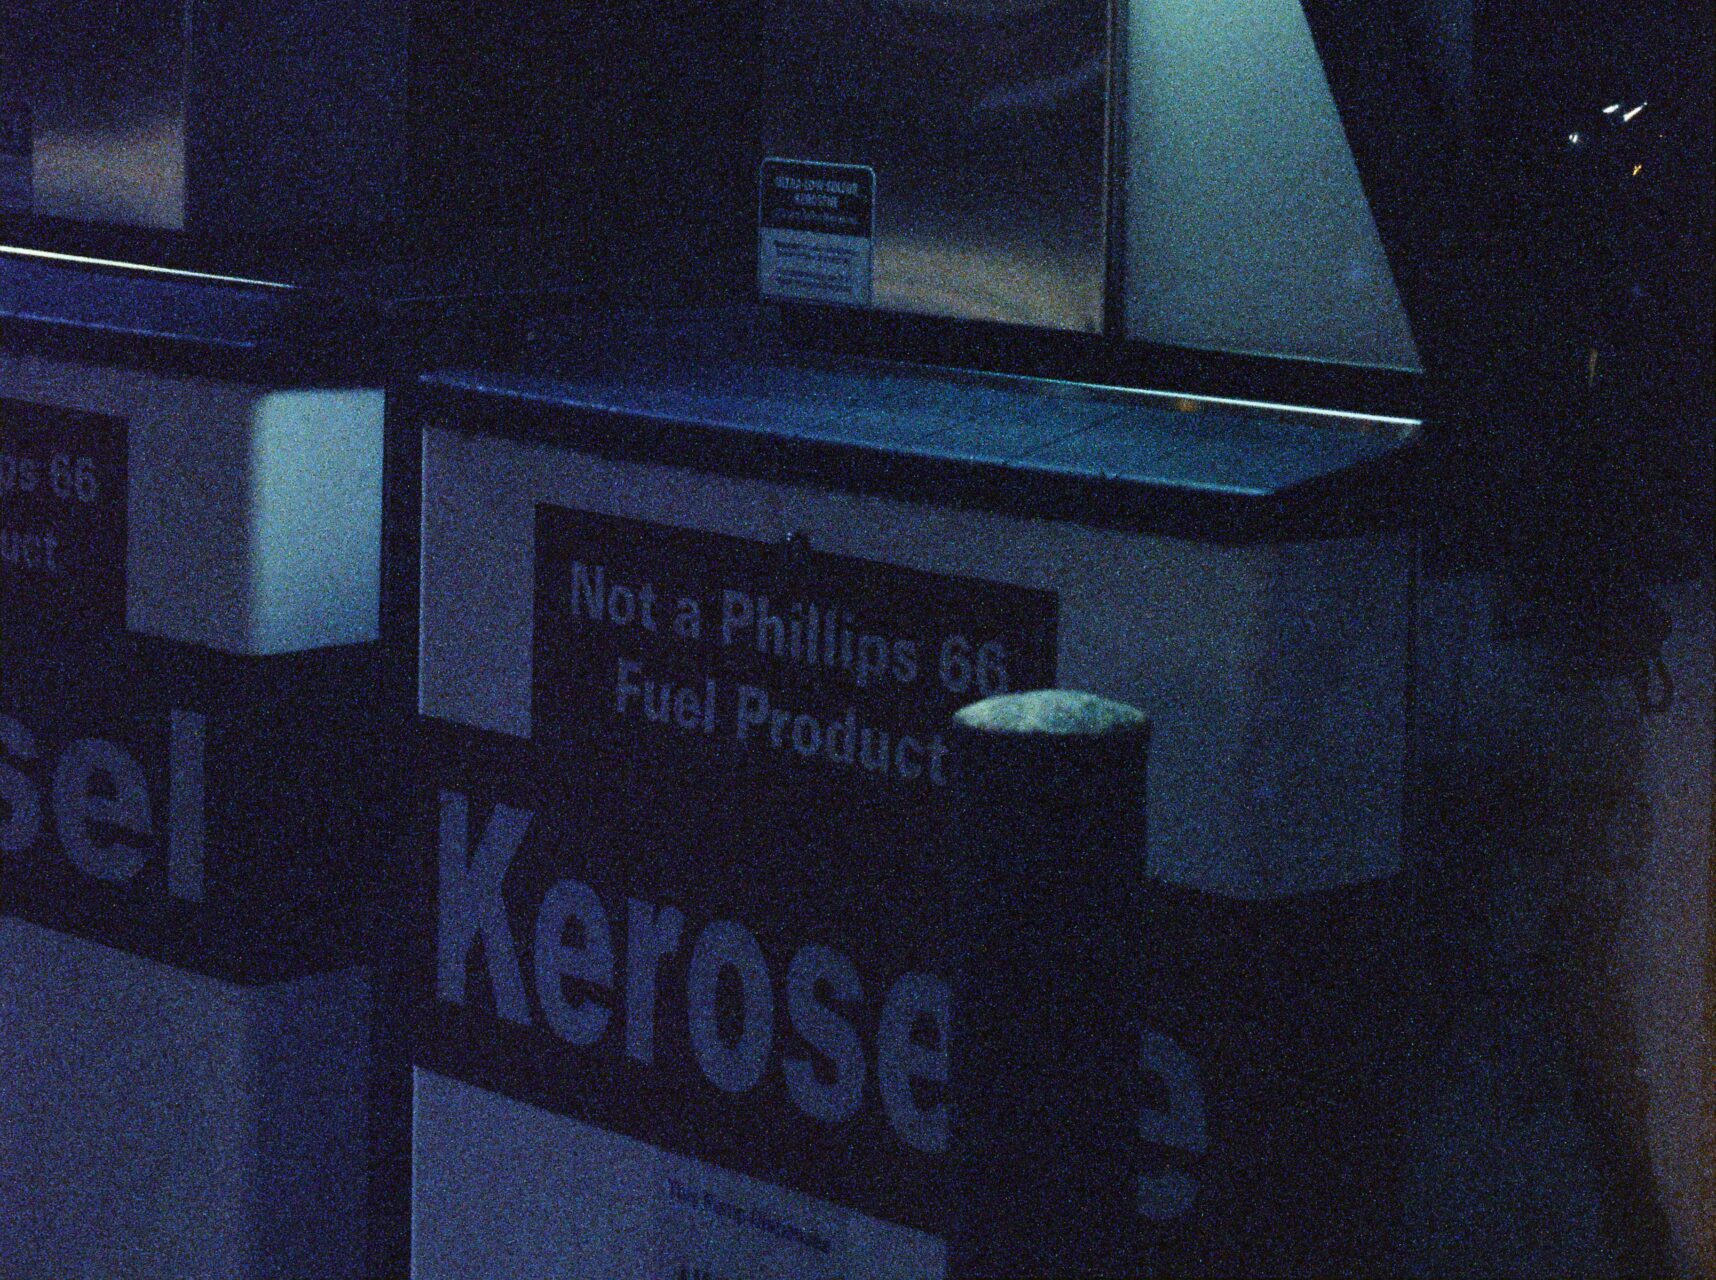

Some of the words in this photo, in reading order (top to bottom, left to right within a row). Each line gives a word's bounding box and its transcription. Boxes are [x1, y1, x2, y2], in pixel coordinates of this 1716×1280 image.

[51, 454, 98, 503] 66
[570, 559, 658, 633] Not
[674, 595, 701, 639] a
[721, 587, 919, 689] Phillips
[938, 633, 1010, 696] 66
[614, 655, 716, 734] Fuel
[736, 683, 949, 787] Product
